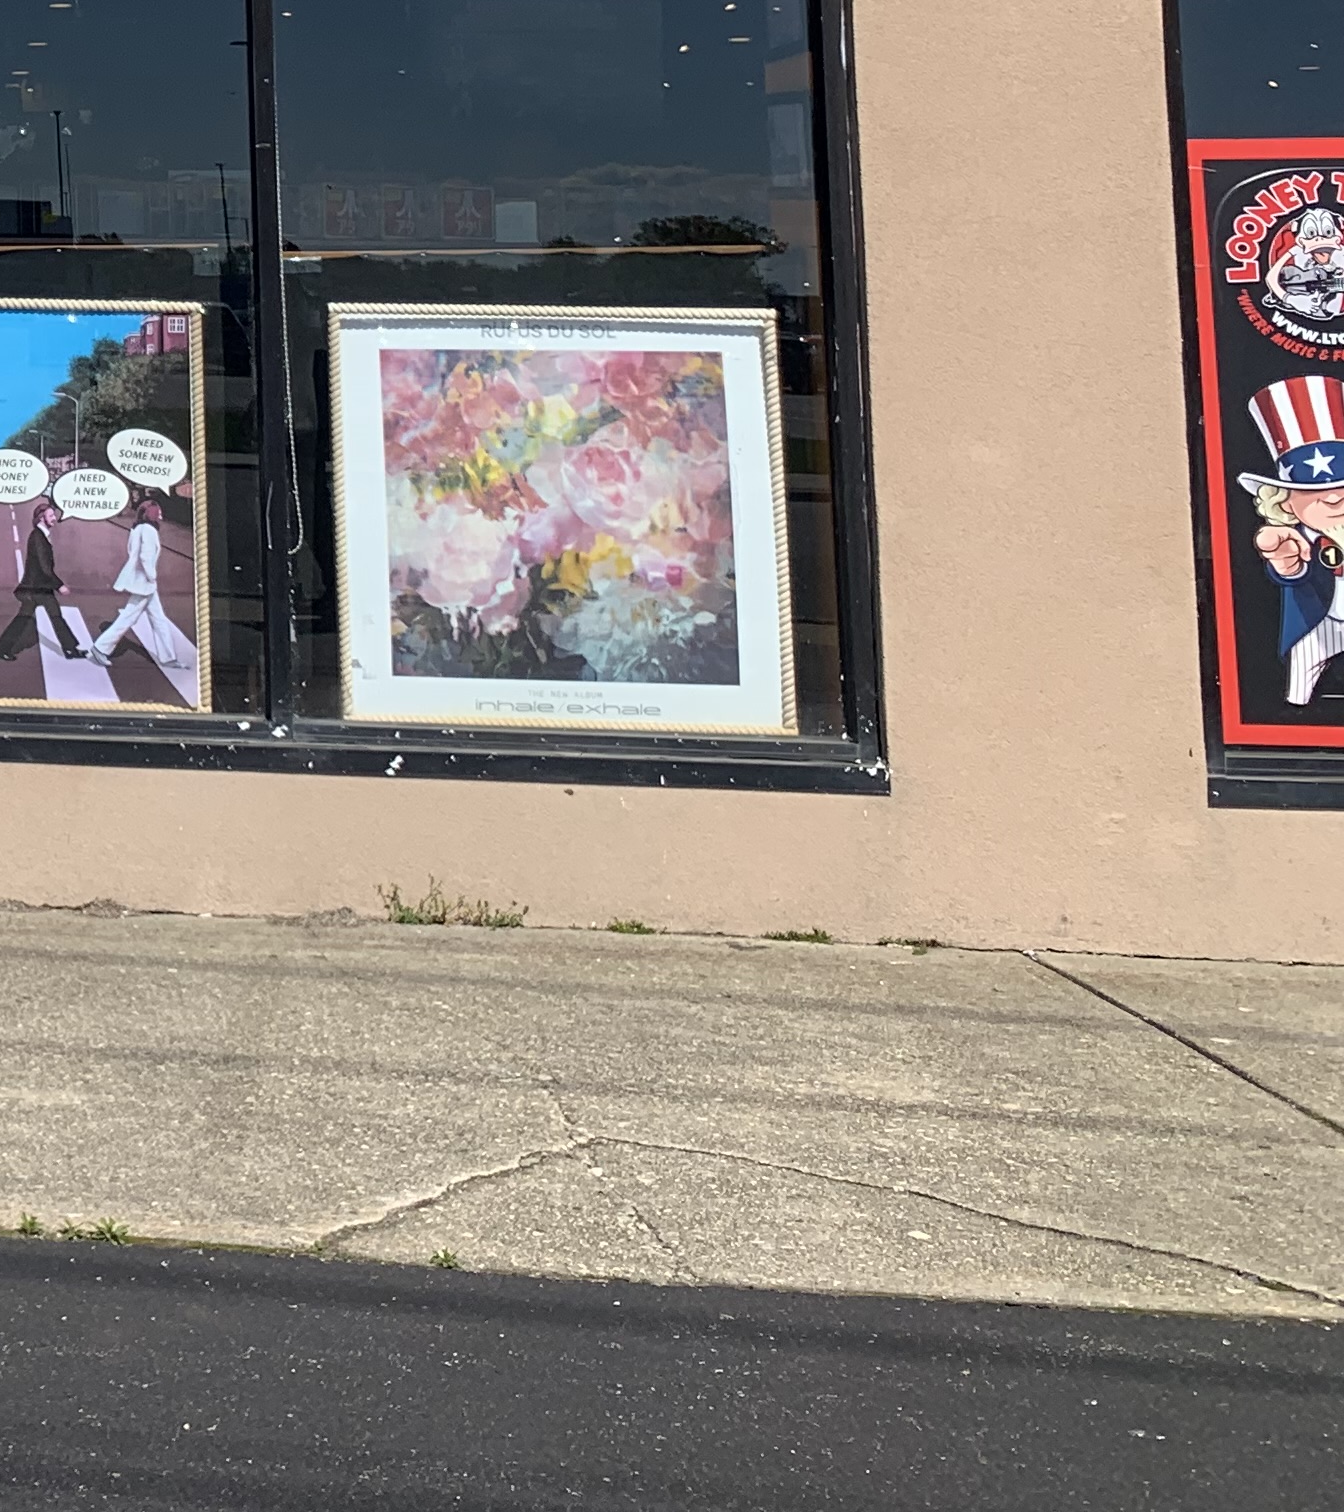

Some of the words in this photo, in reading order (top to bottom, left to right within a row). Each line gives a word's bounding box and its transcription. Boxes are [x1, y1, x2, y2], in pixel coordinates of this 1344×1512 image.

[1225, 171, 1324, 284] LOONEY
[548, 324, 574, 338] DU
[578, 323, 617, 338] SOL
[1270, 333, 1317, 359] MUSIC
[1319, 348, 1329, 361] &
[136, 438, 164, 448] NEED
[118, 449, 149, 460] SOME
[149, 452, 175, 463] NEW
[19, 459, 33, 468] TO
[119, 462, 171, 477] RECORDS!
[73, 473, 77, 482] I
[79, 473, 106, 483] NEED
[74, 487, 81, 496] A
[83, 487, 107, 496] NEW
[62, 499, 120, 510] TURNTABLE
[1325, 547, 1336, 565] 1
[527, 689, 544, 698] THE
[550, 690, 568, 699] NEW
[574, 691, 603, 699] ALBUM
